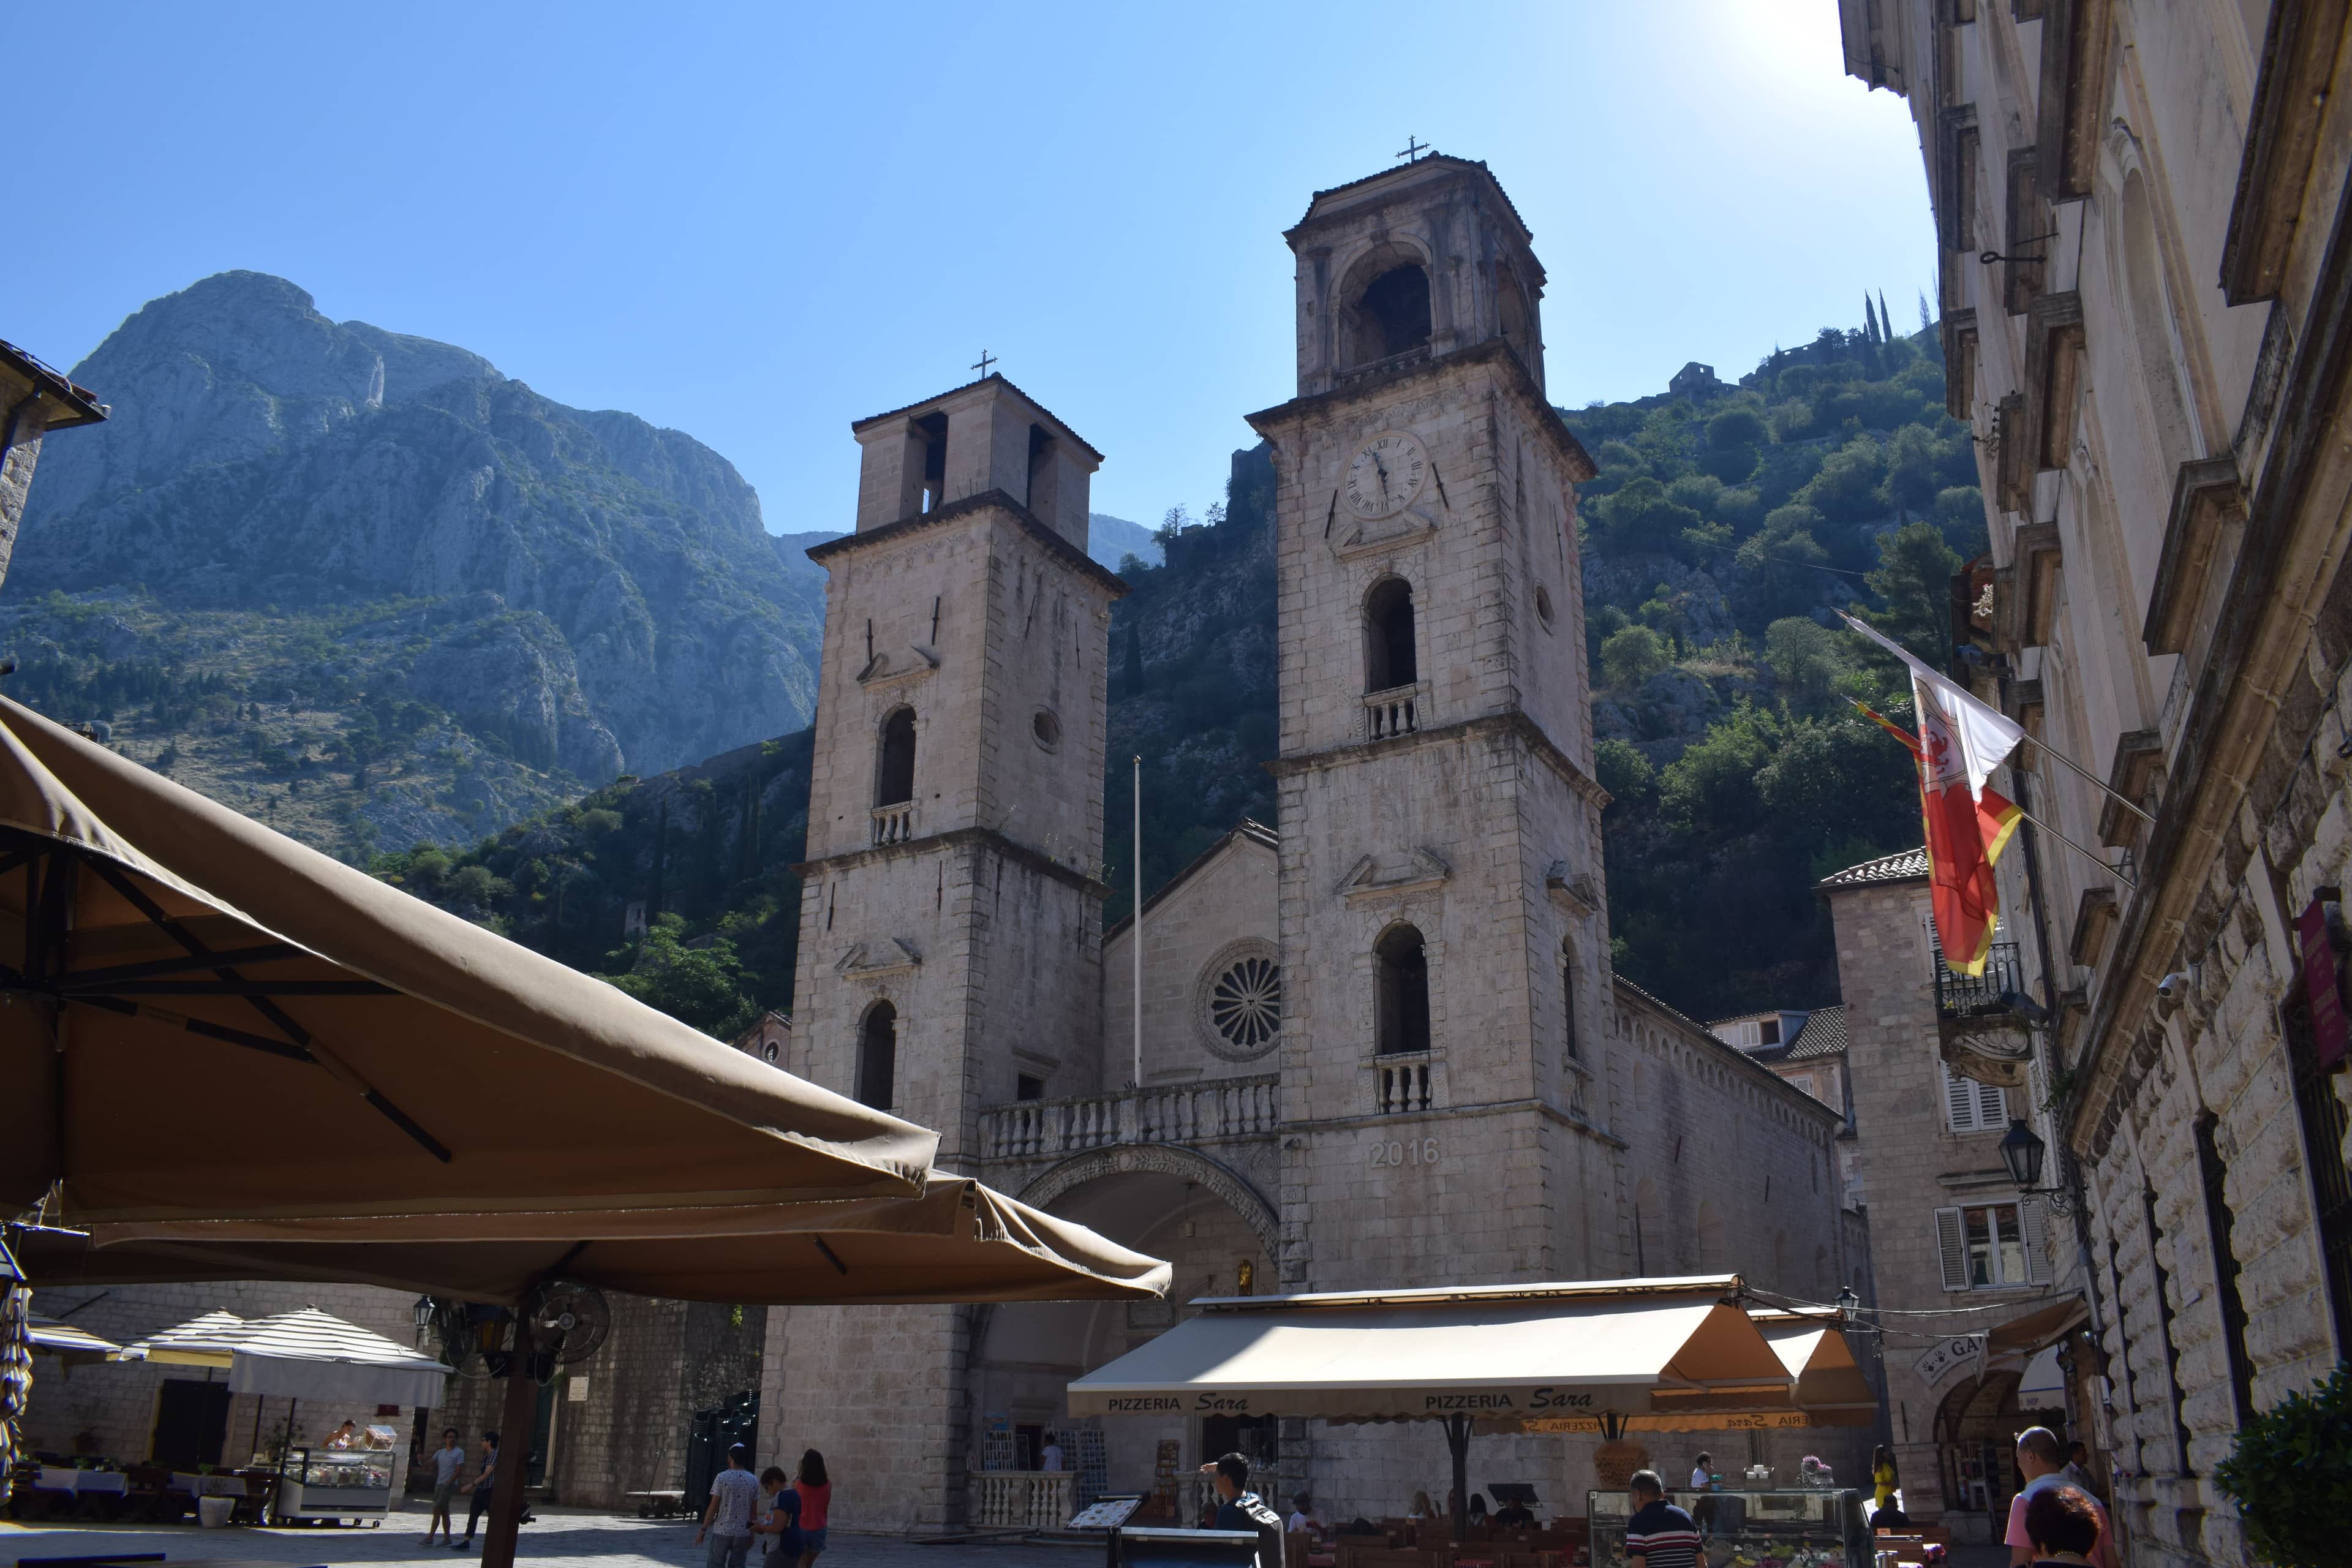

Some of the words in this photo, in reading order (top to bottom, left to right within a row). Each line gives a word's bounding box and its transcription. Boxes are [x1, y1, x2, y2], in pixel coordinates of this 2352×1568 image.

[1370, 1136, 1440, 1169] 2016
[1108, 1397, 1181, 1411] PIZZERIA
[1194, 1392, 1249, 1411] Sara
[1425, 1394, 1513, 1409] PIZZERIA
[1529, 1387, 1594, 1408] Sara
[2026, 1397, 2039, 1407] SHOP
